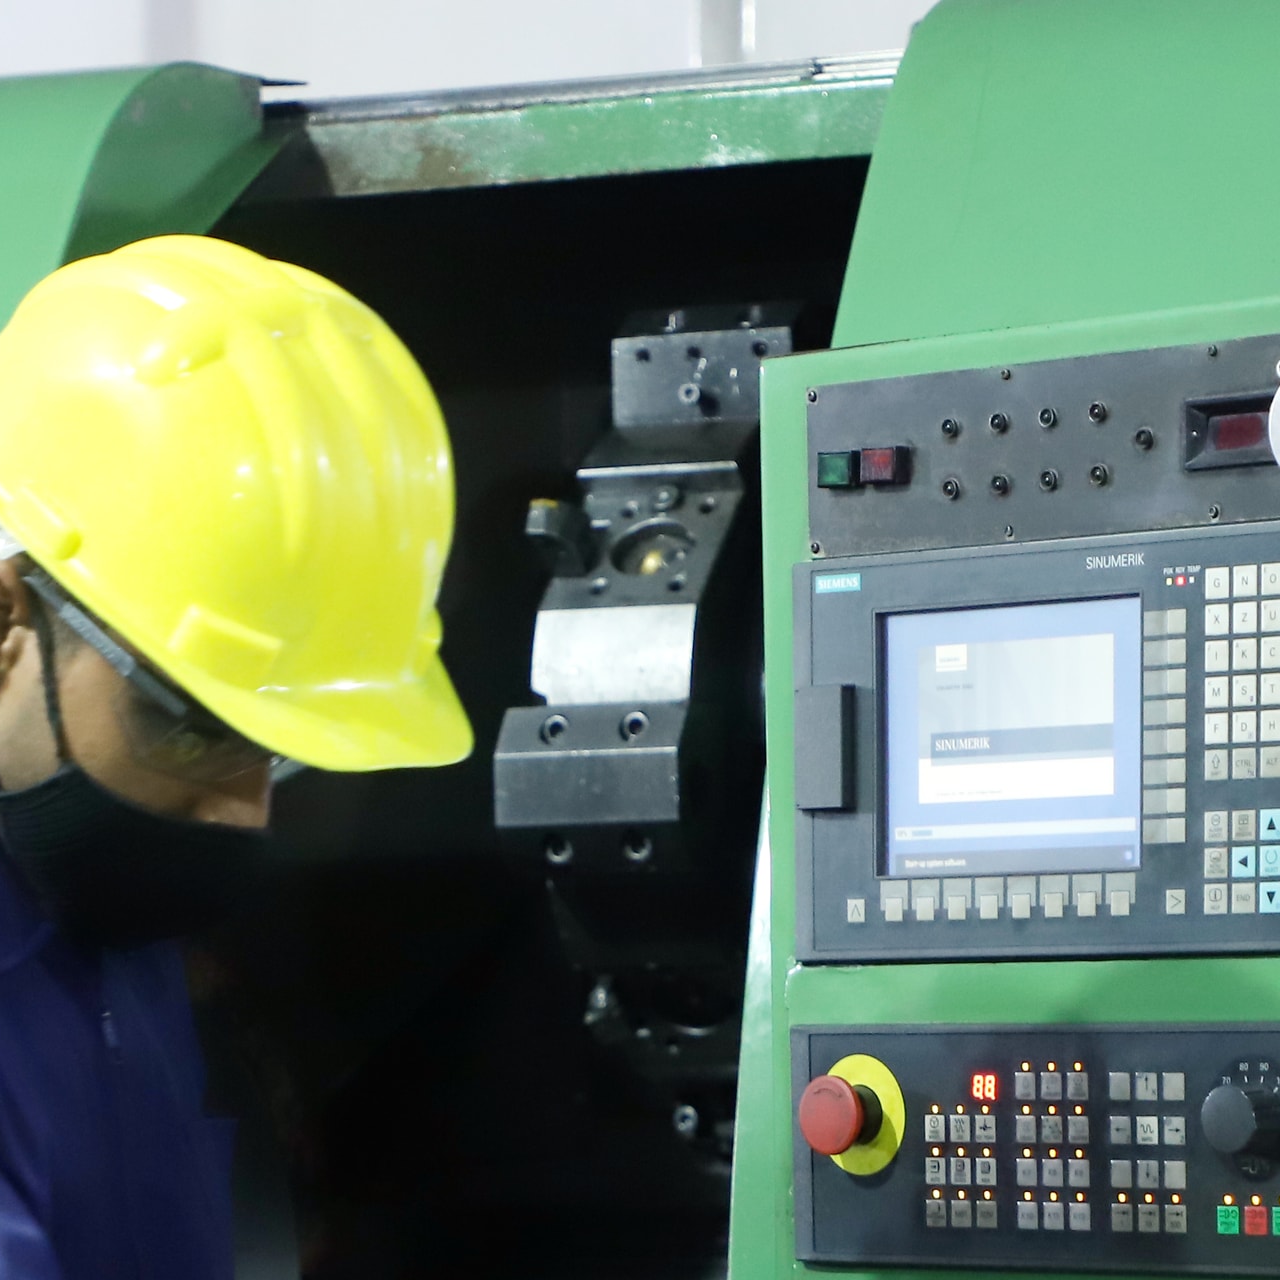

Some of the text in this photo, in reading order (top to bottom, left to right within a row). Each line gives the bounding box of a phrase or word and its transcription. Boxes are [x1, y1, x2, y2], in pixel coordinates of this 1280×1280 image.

[1086, 553, 1145, 570] SINUMERIK
[818, 577, 858, 589] SIEMENS
[1213, 578, 1221, 588] G
[1241, 576, 1249, 586] N
[1213, 614, 1221, 625] X
[1241, 612, 1248, 623] Z
[1269, 610, 1277, 621] U
[1241, 648, 1248, 659] K
[1212, 687, 1221, 697] M
[1241, 686, 1248, 696] S
[1270, 684, 1276, 693] T
[1214, 724, 1218, 733] F
[1240, 722, 1248, 732] D
[1268, 721, 1276, 730] H
[935, 737, 990, 751] SINUMERIK
[1266, 757, 1278, 766] ALT
